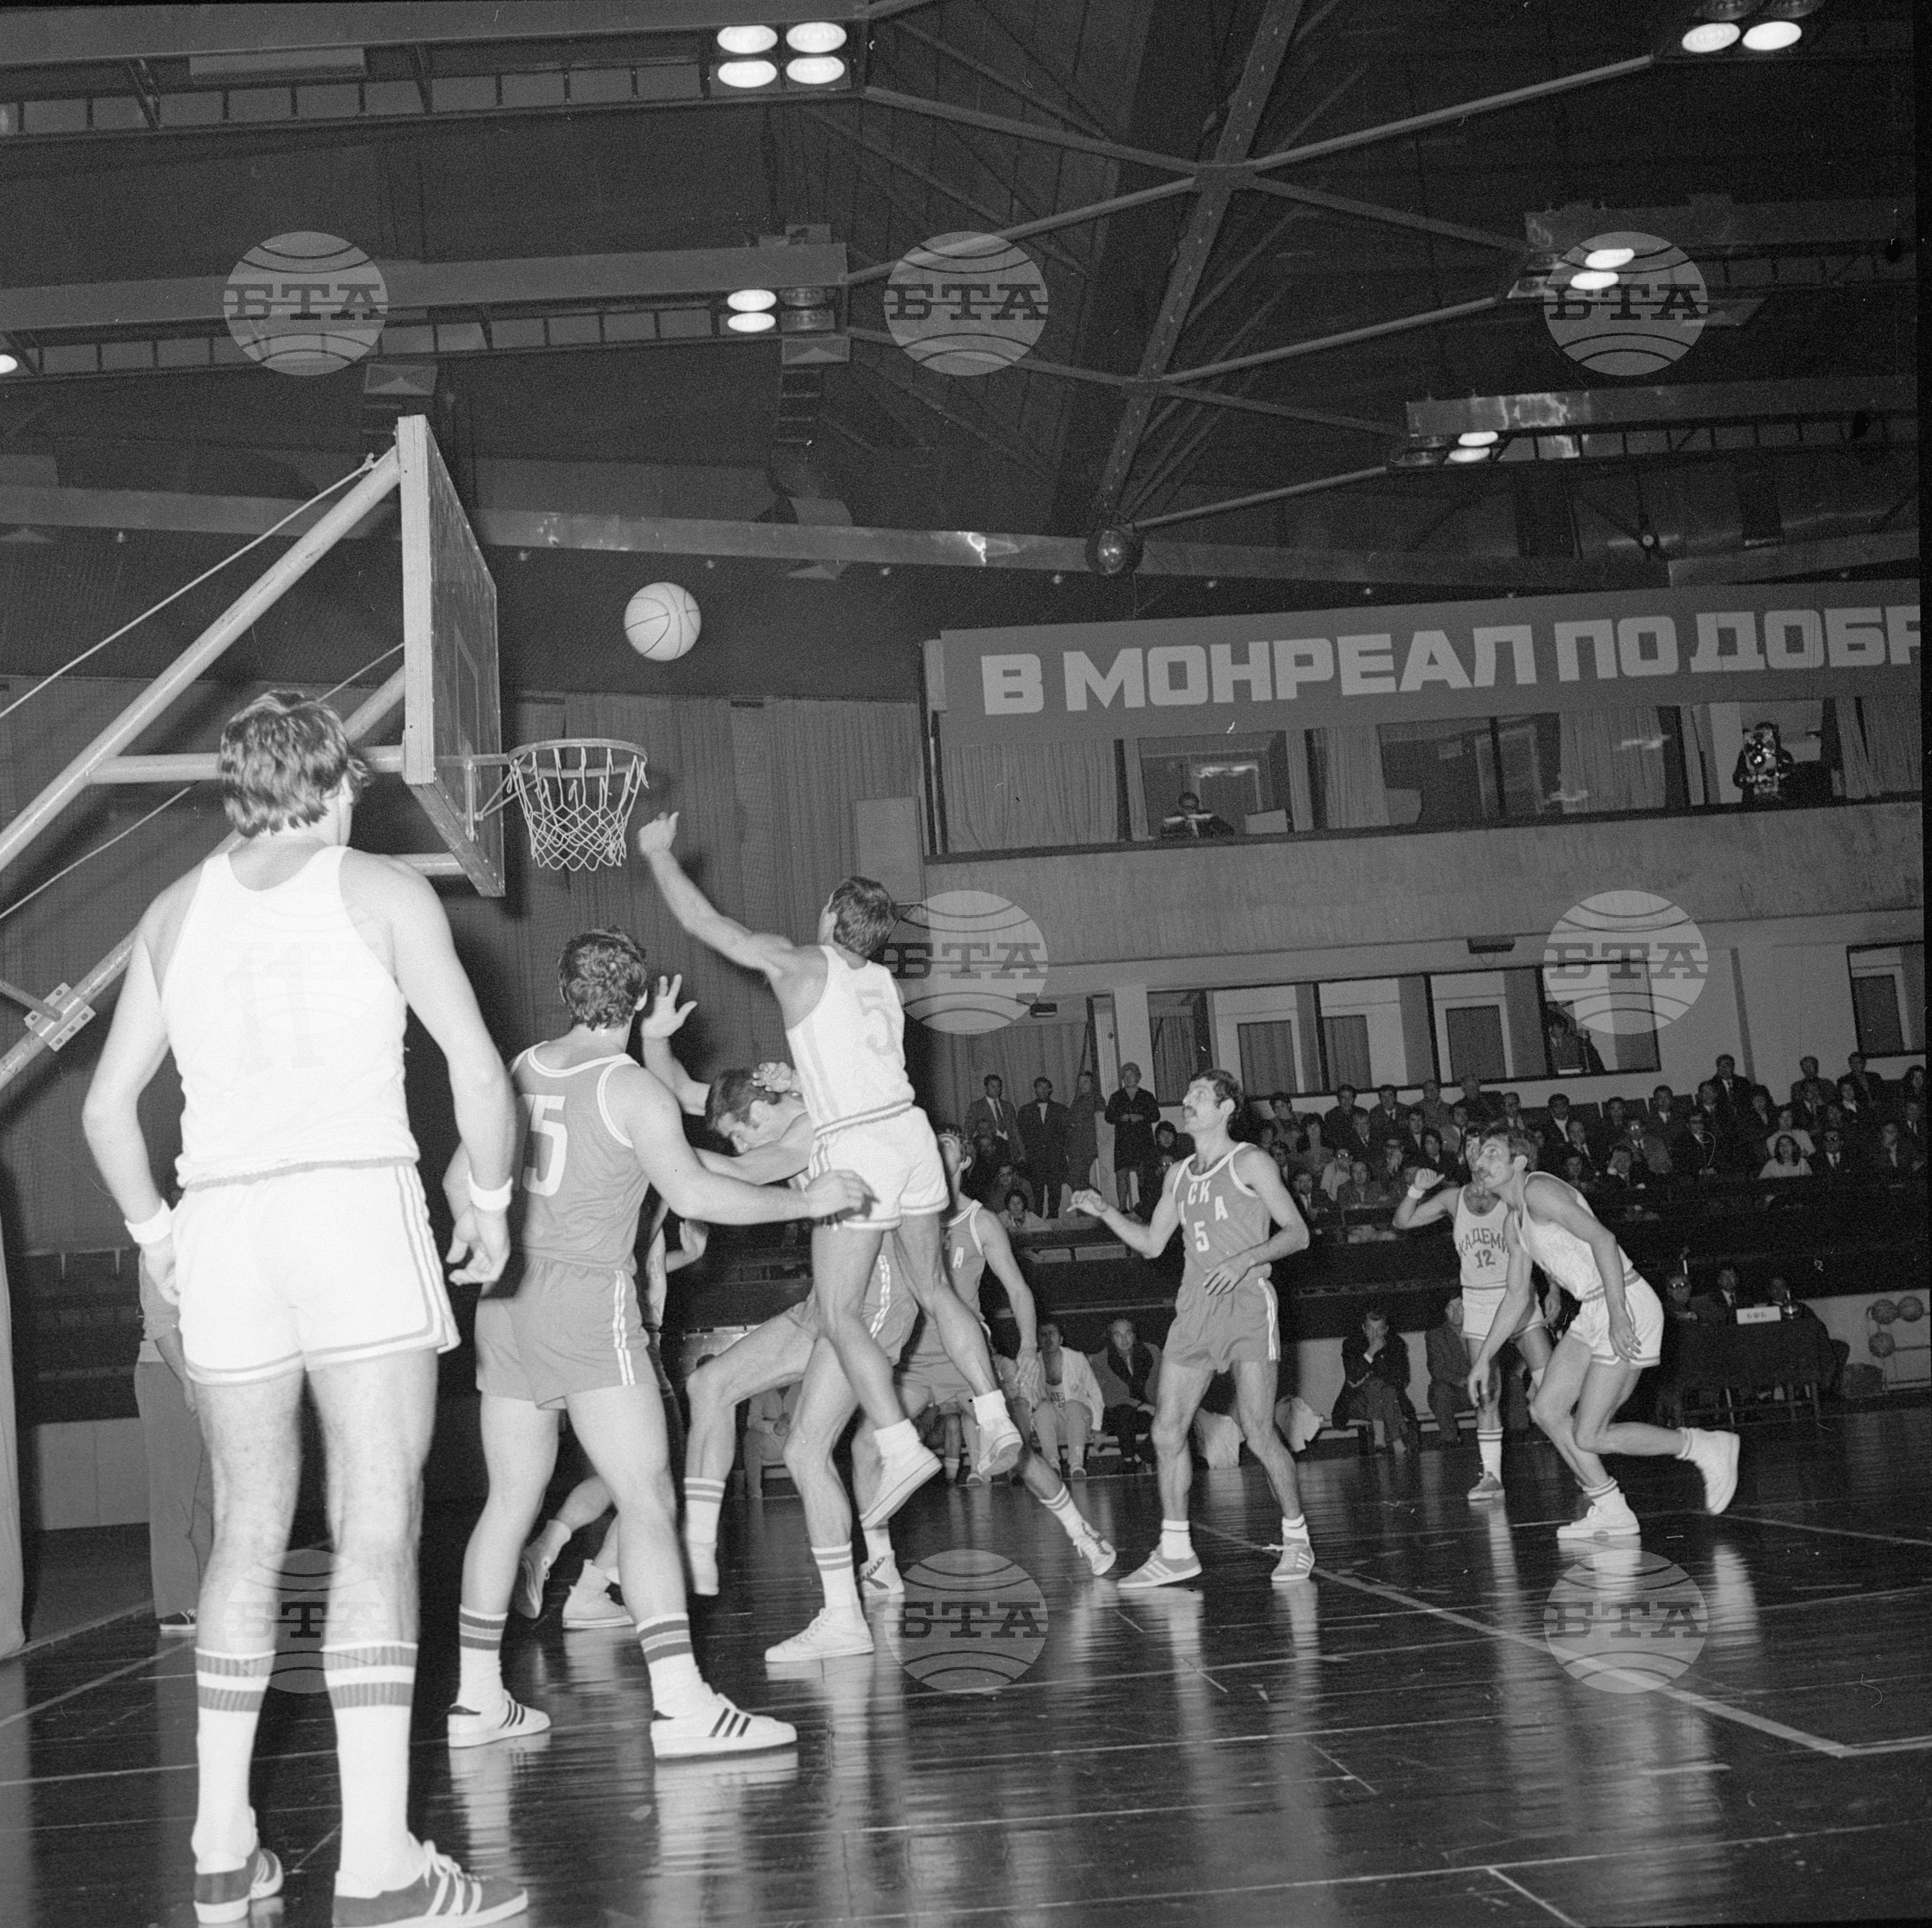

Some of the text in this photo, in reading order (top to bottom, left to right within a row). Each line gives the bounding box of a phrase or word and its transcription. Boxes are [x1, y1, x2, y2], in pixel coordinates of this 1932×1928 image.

[981, 652, 1045, 715] В
[1064, 624, 1538, 712] МОНРЕАЛ
[1553, 615, 1679, 682] ПО
[223, 944, 325, 1076] 11
[856, 988, 897, 1056] 5
[523, 1093, 568, 1197] 5
[1194, 1220, 1210, 1252] 5
[1474, 1249, 1496, 1268] 12
